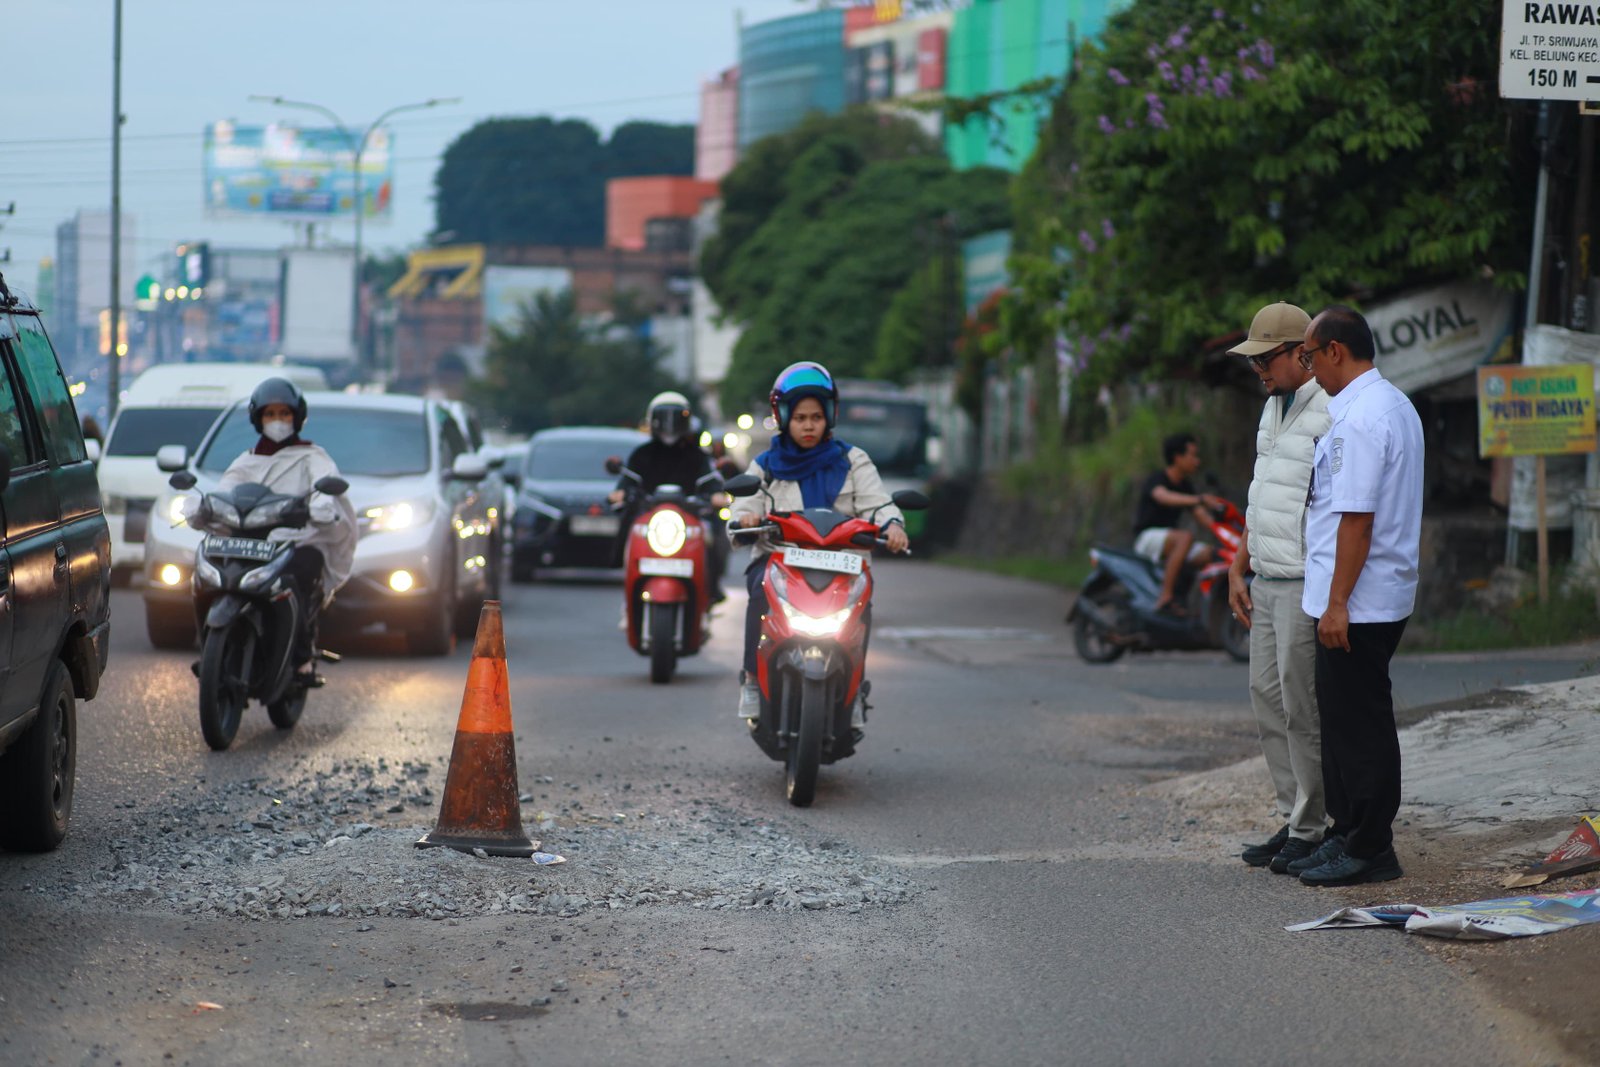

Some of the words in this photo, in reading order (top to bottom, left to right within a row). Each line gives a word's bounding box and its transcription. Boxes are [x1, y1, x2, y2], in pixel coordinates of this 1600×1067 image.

[1533, 35, 1546, 46] TP.
[1548, 36, 1598, 48] SRIWIJAYA
[1510, 49, 1531, 60] KEL.
[1534, 50, 1575, 62] BELIUNG
[1528, 68, 1557, 87] 150
[1563, 70, 1577, 88] M
[1372, 300, 1477, 355] LOYAL
